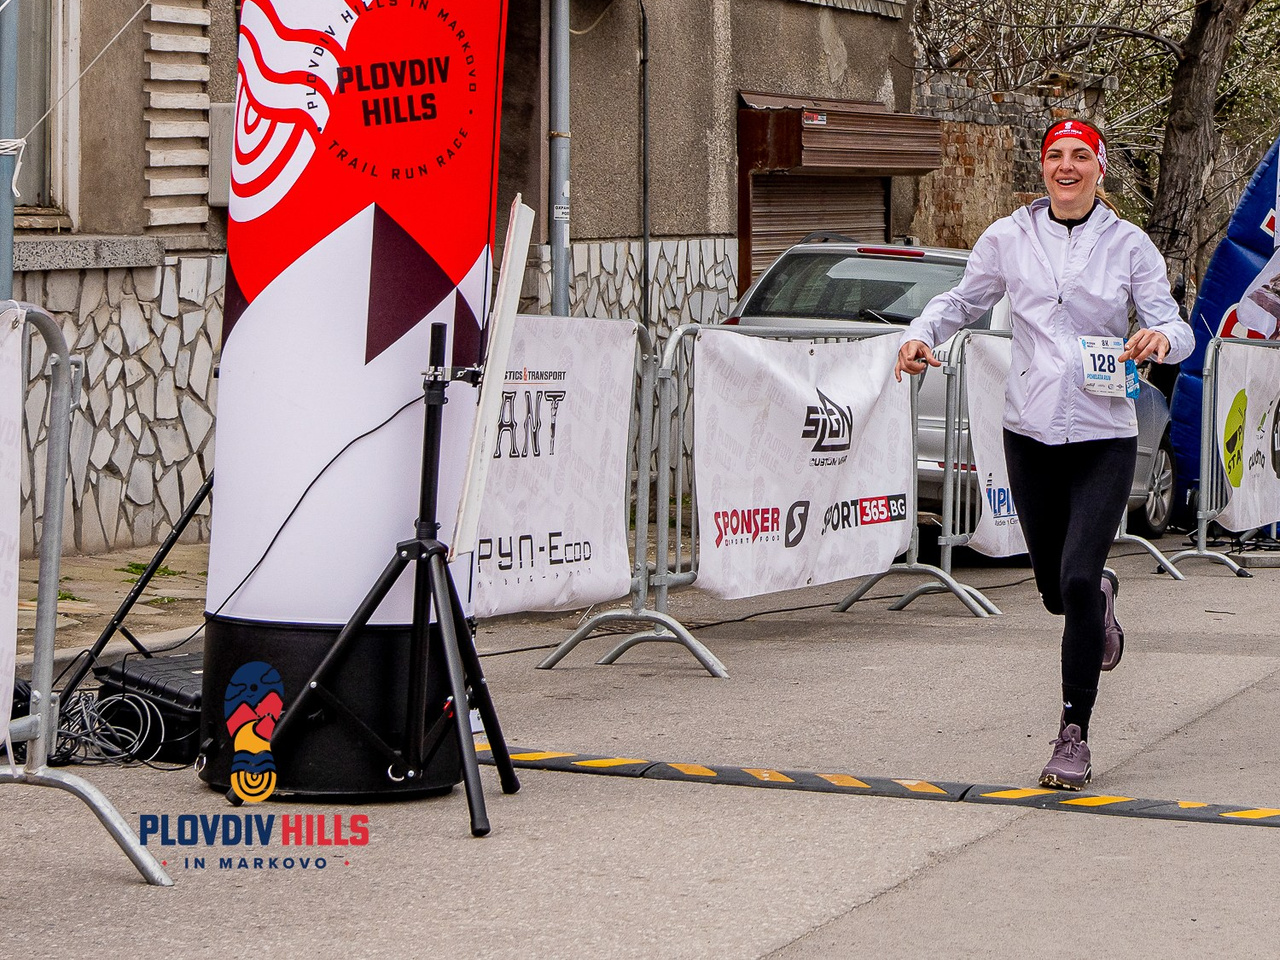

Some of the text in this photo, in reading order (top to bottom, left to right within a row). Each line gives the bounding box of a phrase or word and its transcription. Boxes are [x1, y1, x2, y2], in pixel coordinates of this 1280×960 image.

[306, 25, 336, 109] PLOVDIV
[437, 8, 476, 93] MARKOVO
[336, 56, 450, 94] PLOVDIV
[362, 93, 437, 127] HILLS
[328, 127, 468, 180] TRAIL RUN RACE
[528, 371, 566, 381] TRANSPORT
[1090, 353, 1116, 374] 128
[714, 507, 780, 548] SPONSER
